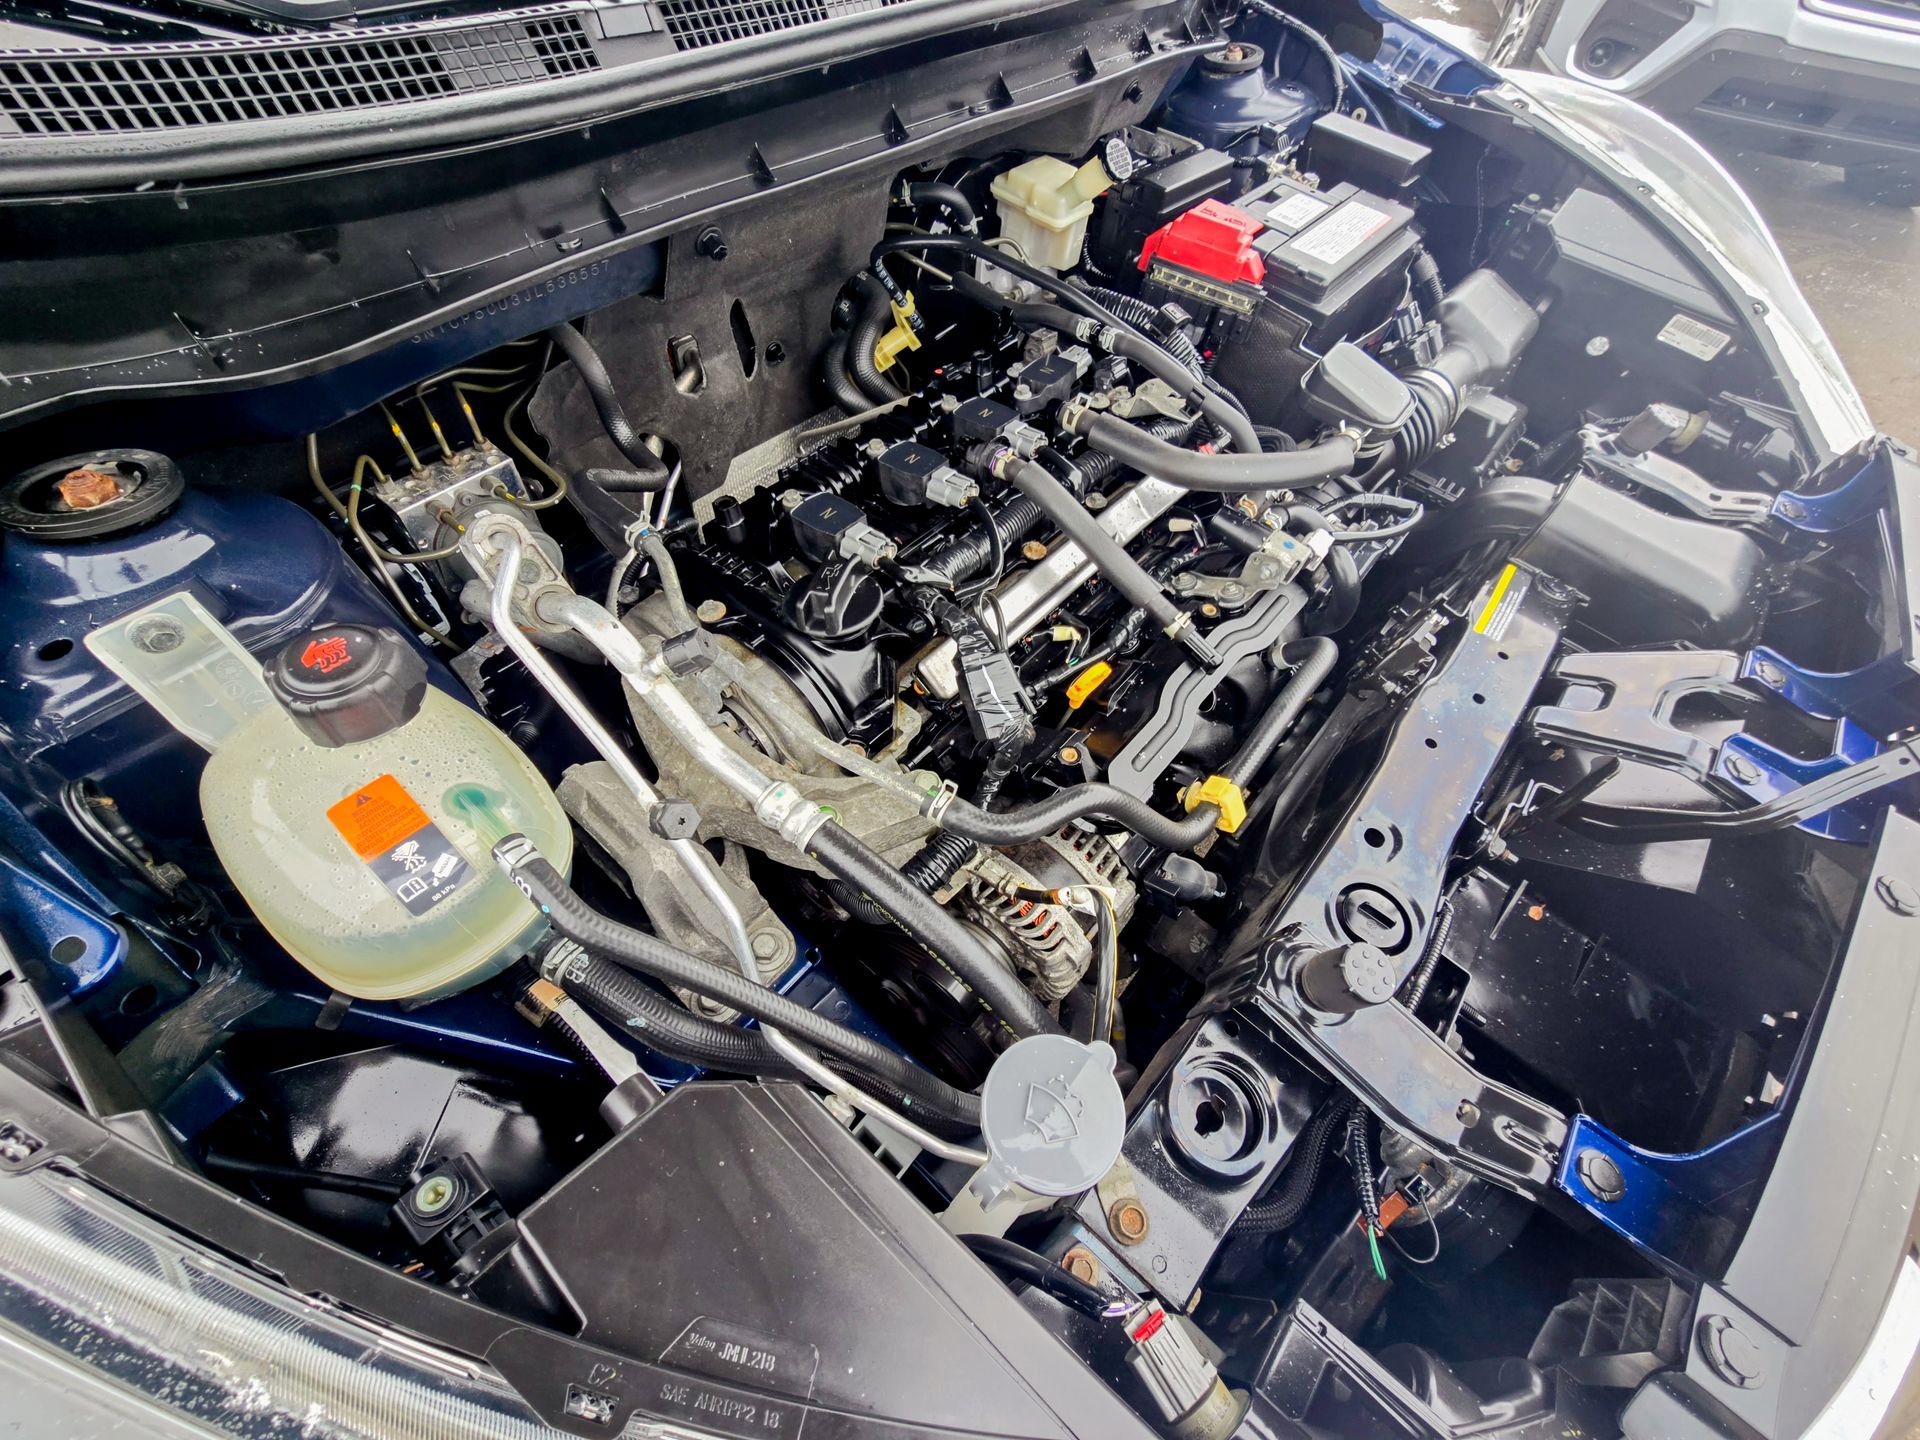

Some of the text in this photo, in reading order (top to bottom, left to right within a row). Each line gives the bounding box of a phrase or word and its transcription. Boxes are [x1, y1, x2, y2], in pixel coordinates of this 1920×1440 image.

[904, 453, 920, 464] N
[819, 507, 838, 519] N
[659, 1383, 690, 1406] SAE
